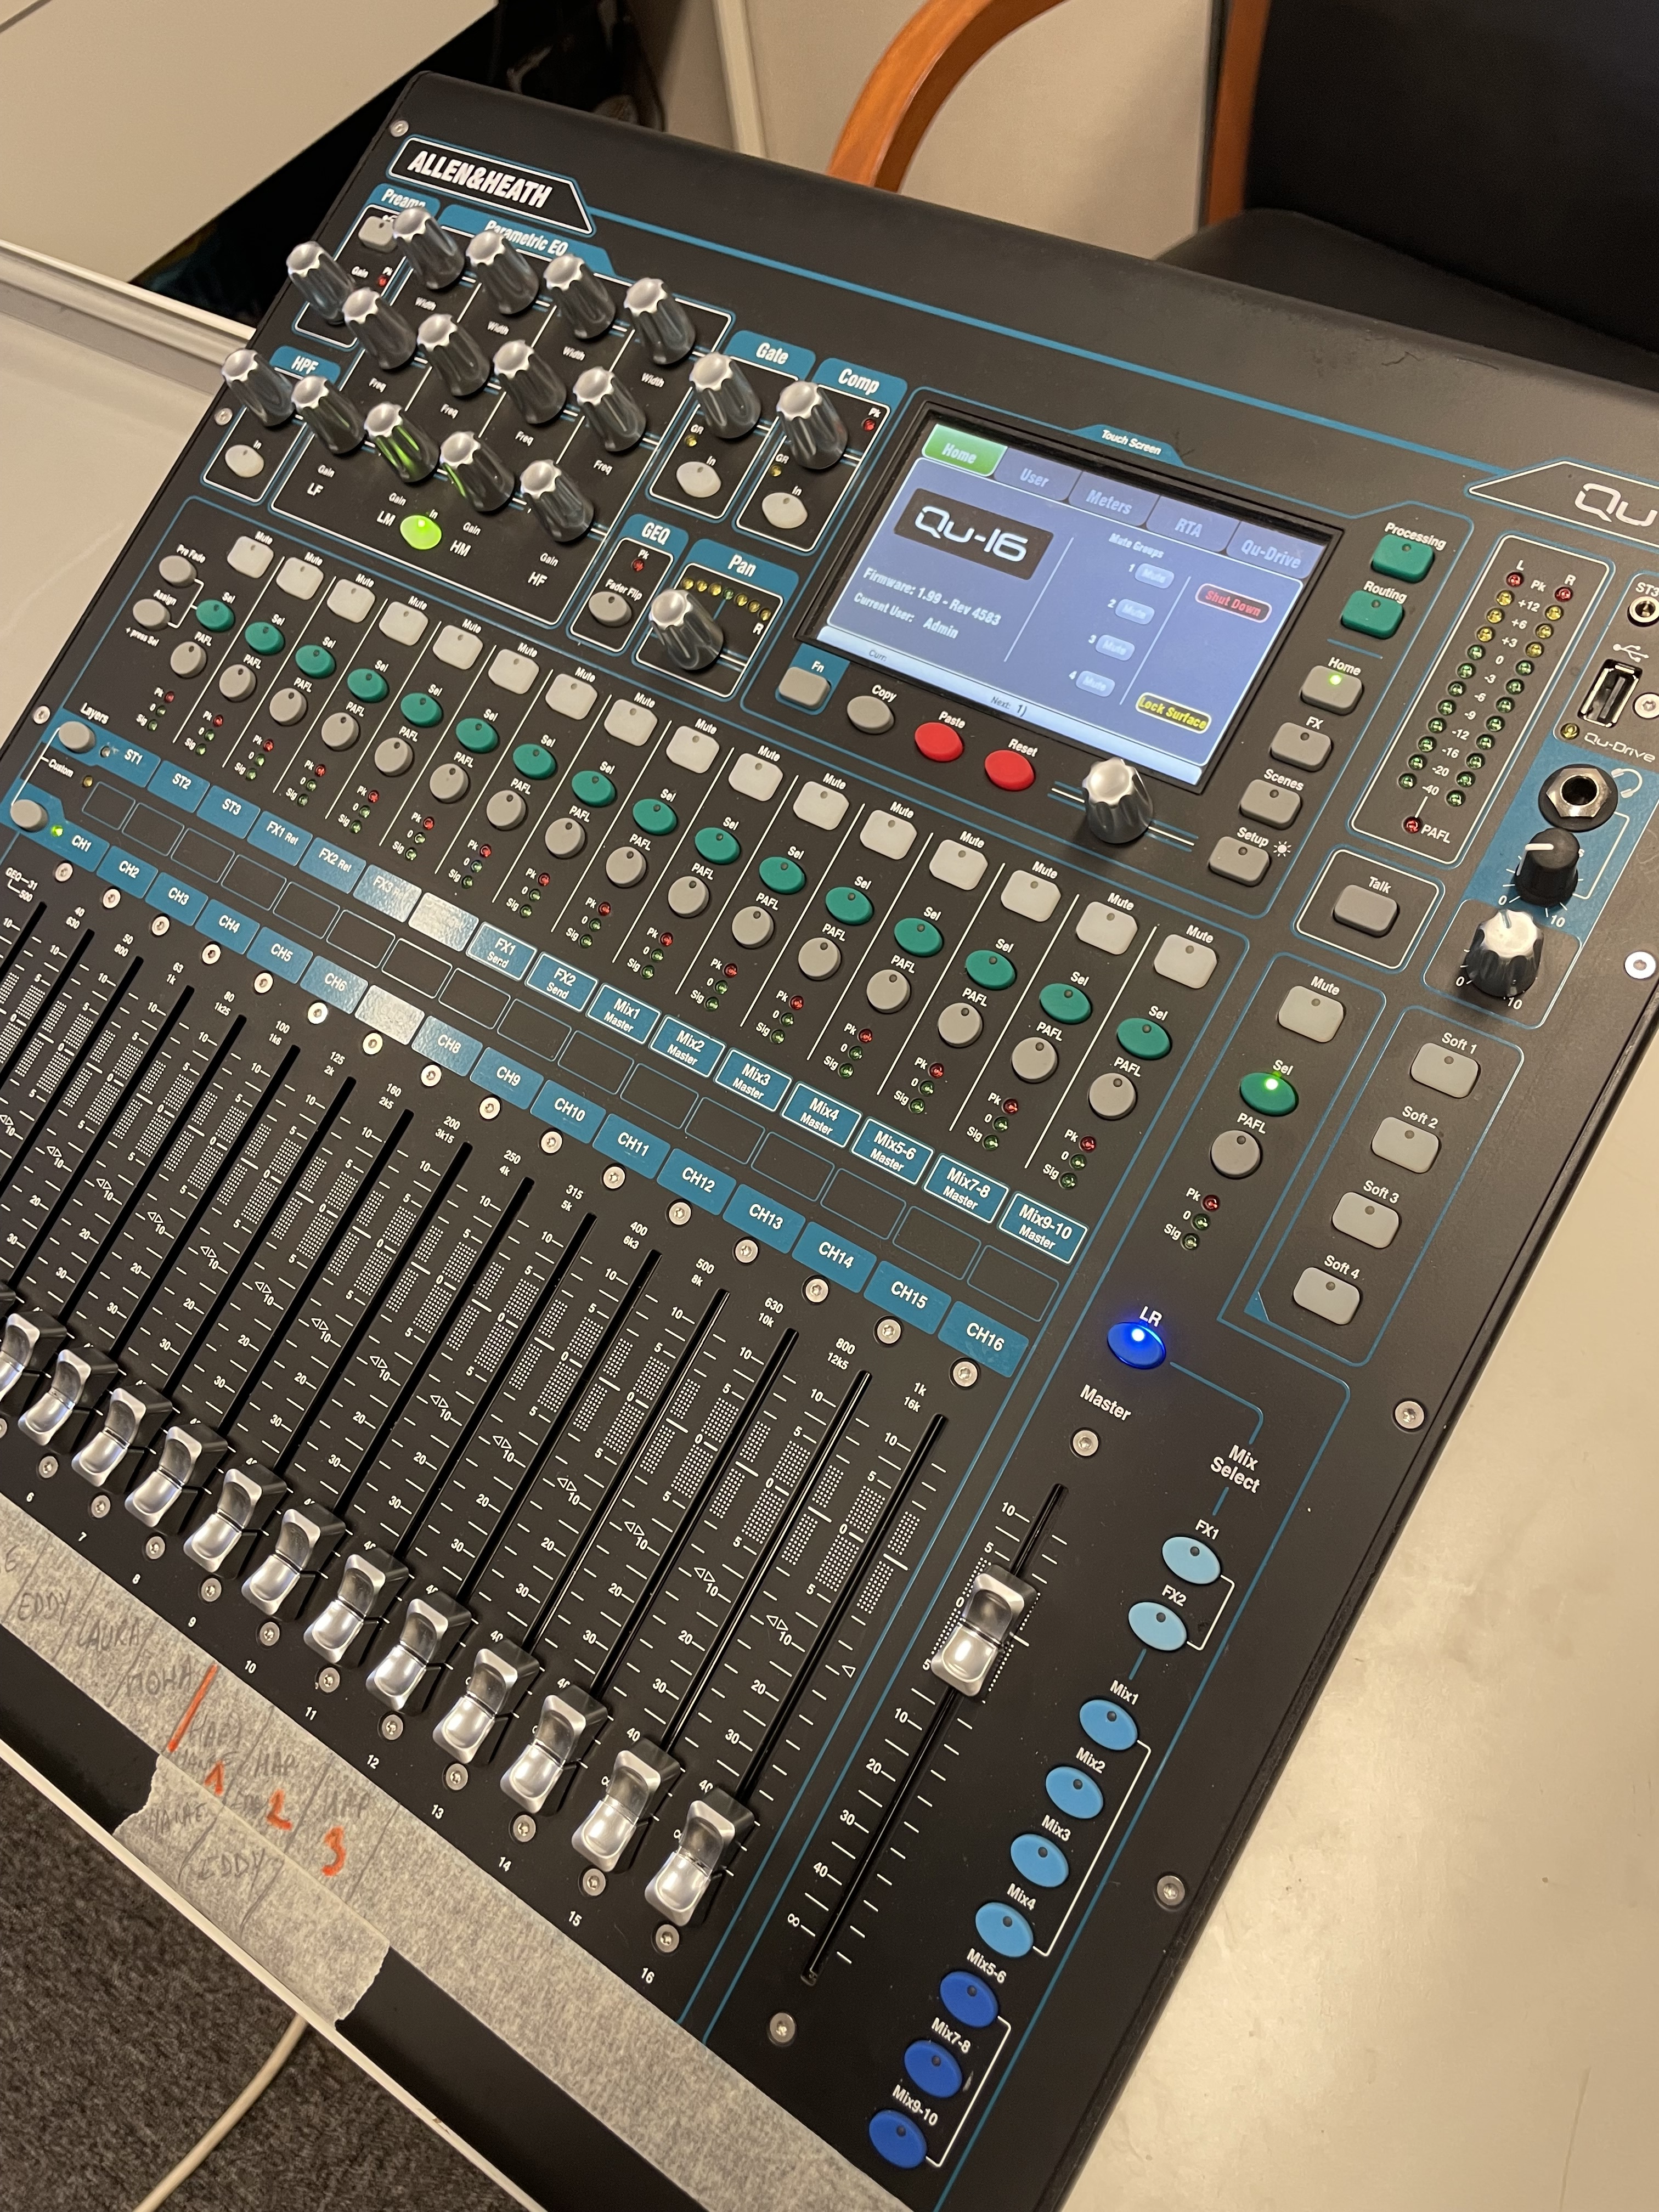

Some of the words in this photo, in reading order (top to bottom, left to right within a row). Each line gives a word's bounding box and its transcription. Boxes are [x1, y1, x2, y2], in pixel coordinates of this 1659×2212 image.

[408, 150, 552, 208] ALLEN&HEATH
[755, 342, 789, 365] Gate
[291, 356, 319, 374] HPF
[641, 373, 665, 387] Width
[838, 368, 880, 396] Comp
[690, 424, 704, 435] GR
[1102, 430, 1128, 445] Touch
[1128, 438, 1161, 455] Screen
[942, 443, 977, 465] Home
[593, 459, 613, 475] Freq
[1019, 467, 1049, 488] User
[307, 482, 324, 496] LF
[1086, 489, 1132, 516] Meters
[1575, 483, 1658, 527] Qu
[376, 511, 396, 526] LM
[429, 509, 438, 520] In
[462, 521, 481, 535] Gain
[641, 522, 671, 545] GEQ
[915, 506, 1028, 562] Qu-16
[1174, 518, 1203, 537] RTA
[1384, 522, 1447, 551] Processing
[449, 540, 471, 557] HM
[637, 549, 649, 560] Pk
[1109, 533, 1132, 549] Mute
[1132, 540, 1164, 558] Groups
[1241, 539, 1302, 569] Qu-Drive
[540, 552, 559, 566] Gain
[727, 554, 757, 577] Pan
[1516, 560, 1525, 571] L
[528, 572, 548, 587] HF
[1531, 579, 1547, 592] Pk
[1565, 574, 1576, 586] R
[154, 589, 177, 606] Assign
[605, 579, 628, 594] Fader
[625, 586, 643, 601] Flip
[862, 567, 916, 595] Firmware:
[917, 587, 943, 605] 1.99
[949, 599, 971, 616] Rev
[972, 607, 1001, 626] 4583
[1363, 580, 1407, 603] Routing
[1635, 582, 1659, 597] ST3
[1204, 590, 1231, 608] Shut
[1231, 599, 1262, 617] Down
[1519, 599, 1540, 612] +12
[854, 592, 890, 614] Current
[889, 606, 915, 623] User:
[923, 617, 959, 639] Admin
[1511, 618, 1527, 629] +6
[753, 622, 764, 635] R
[194, 631, 212, 647] PAFL
[1502, 636, 1517, 647] +3
[811, 661, 825, 673] Fn
[1328, 657, 1361, 675] Home
[1495, 656, 1504, 665] 0
[1485, 674, 1496, 684] -3
[871, 684, 898, 702] Copy
[990, 696, 1012, 709] Next:
[1474, 692, 1486, 702] -6
[80, 703, 109, 725] Layers
[938, 710, 966, 729] Paste
[1138, 696, 1164, 714] Lock
[1165, 707, 1207, 729] Surface
[1464, 710, 1477, 720] -9
[1306, 715, 1323, 730] FX
[1452, 727, 1470, 740] -12
[124, 749, 143, 765] ST1
[758, 745, 780, 761] Mute
[1008, 738, 1039, 758] Reset
[1442, 746, 1459, 758] -16
[1584, 732, 1656, 763] Qu-Drive
[48, 759, 74, 777] Custom
[1432, 765, 1449, 777] -20
[172, 773, 192, 790] ST2
[1263, 769, 1304, 790] Scenes
[1422, 784, 1440, 796] -40
[222, 798, 242, 815] ST3
[266, 821, 285, 838] FX1
[284, 832, 298, 845] Ret
[1237, 827, 1269, 848] Setup
[1421, 824, 1451, 843] PAFL
[71, 835, 92, 851] CH1
[318, 848, 338, 866] FX2
[337, 859, 352, 872] Ret
[691, 862, 714, 881] PAFL
[1368, 877, 1392, 893] Talk
[167, 887, 189, 905] CH3
[1107, 893, 1135, 911] Mute
[1550, 914, 1566, 928] 10
[270, 944, 294, 962] CH5
[995, 938, 1014, 954] Sel
[554, 968, 577, 986] FX2
[1311, 975, 1340, 995] Mute
[546, 983, 569, 1001] Send
[613, 998, 641, 1019] Mix1
[437, 1034, 462, 1053] CH8
[676, 1030, 705, 1052] Mix2
[1441, 1032, 1469, 1050] Soft
[1470, 1044, 1478, 1054] 1
[496, 1066, 521, 1087] CH9
[741, 1063, 771, 1086] Mix3
[1272, 1059, 1294, 1076] Sel
[554, 1097, 586, 1122] CH10
[809, 1098, 840, 1121] Mix4
[1402, 1105, 1429, 1124] Soft
[1428, 1118, 1439, 1129] 2
[1237, 1112, 1268, 1135] PAFL
[617, 1132, 650, 1157] CH11
[873, 1130, 916, 1161] Mix5-6
[503, 1150, 521, 1165] 250
[681, 1167, 715, 1193] CH12
[1042, 1164, 1059, 1181] Sig
[566, 1185, 584, 1199] 315
[946, 1167, 992, 1199] Mix7-8
[1362, 1180, 1390, 1199] Soft
[1389, 1192, 1400, 1204] 3
[1186, 1187, 1201, 1202] Pk
[748, 1203, 784, 1230] CH13
[1018, 1204, 1074, 1240] Mix9-10
[1183, 1210, 1192, 1220] 0
[1018, 1224, 1057, 1250] Master
[1163, 1223, 1182, 1241] Sig
[818, 1242, 855, 1269] CH14
[1324, 1255, 1351, 1275] Soft
[1350, 1267, 1361, 1279] 4
[890, 1280, 929, 1309] CH15
[1139, 1306, 1163, 1327] LR
[966, 1323, 1006, 1352] CH16
[826, 1352, 849, 1371] 12k5
[913, 1381, 927, 1396] 1k
[904, 1396, 921, 1413] 16k
[1079, 1385, 1132, 1421] Master
[1227, 1444, 1259, 1471] Mix
[1210, 1457, 1261, 1494] Select
[1001, 1502, 1015, 1516] 10
[1194, 1519, 1220, 1540] FX1
[1161, 1584, 1187, 1606] FX2
[1110, 1680, 1139, 1705] Mix1
[1075, 1747, 1106, 1774] Mix2
[839, 1810, 856, 1826] 30
[1041, 1814, 1071, 1842] Mix3
[498, 1857, 512, 1872] 14
[813, 1862, 828, 1878] 40
[1007, 1883, 1037, 1911] Mix4
[641, 1967, 655, 1984] 16
[966, 1948, 1008, 1984] Mix5-6
[931, 2017, 972, 2054] Mix7-8
[891, 2084, 939, 2126] Mix9-10
